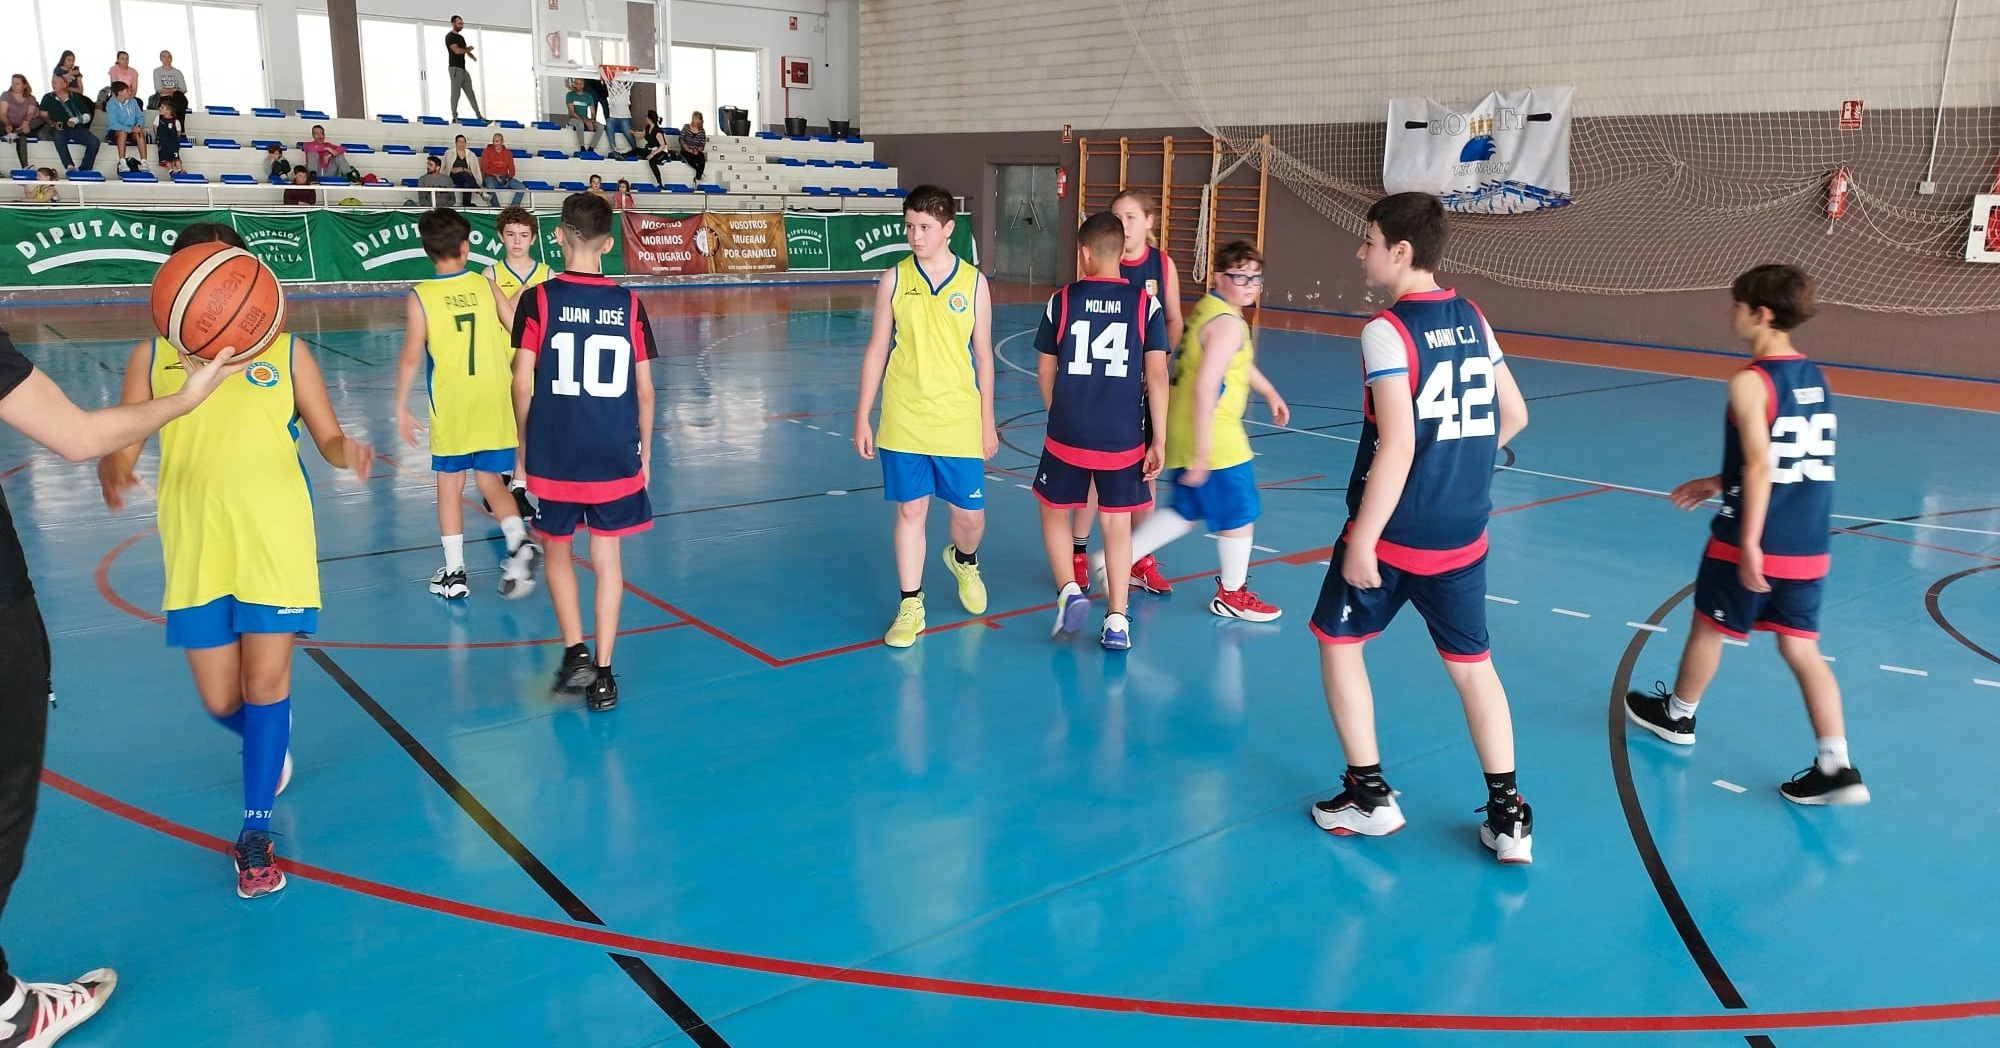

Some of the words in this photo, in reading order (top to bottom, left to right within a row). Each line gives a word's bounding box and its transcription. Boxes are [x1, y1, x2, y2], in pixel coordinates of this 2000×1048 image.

[729, 220, 768, 230] VOSOTROS
[15, 220, 179, 260] DIPUTACIO
[244, 230, 301, 242] DIPUTACION
[352, 223, 504, 258] DIPUTON
[641, 235, 683, 246] MORIMOS
[732, 234, 766, 245] MUERAN
[257, 253, 303, 262] EVILLA
[638, 252, 656, 261] POR
[657, 251, 692, 263] JUGARLO
[724, 249, 741, 259] POR
[741, 248, 777, 259] GANARLO
[788, 247, 824, 255] SEVILLA
[443, 292, 478, 310] PABLO
[1085, 298, 1122, 314] MOLINA
[558, 306, 590, 324] JUAN
[595, 307, 625, 327] JOSÉ
[454, 312, 476, 376] 7
[1068, 320, 1130, 377] 14
[551, 332, 631, 398] 10
[1416, 356, 1496, 442] 42
